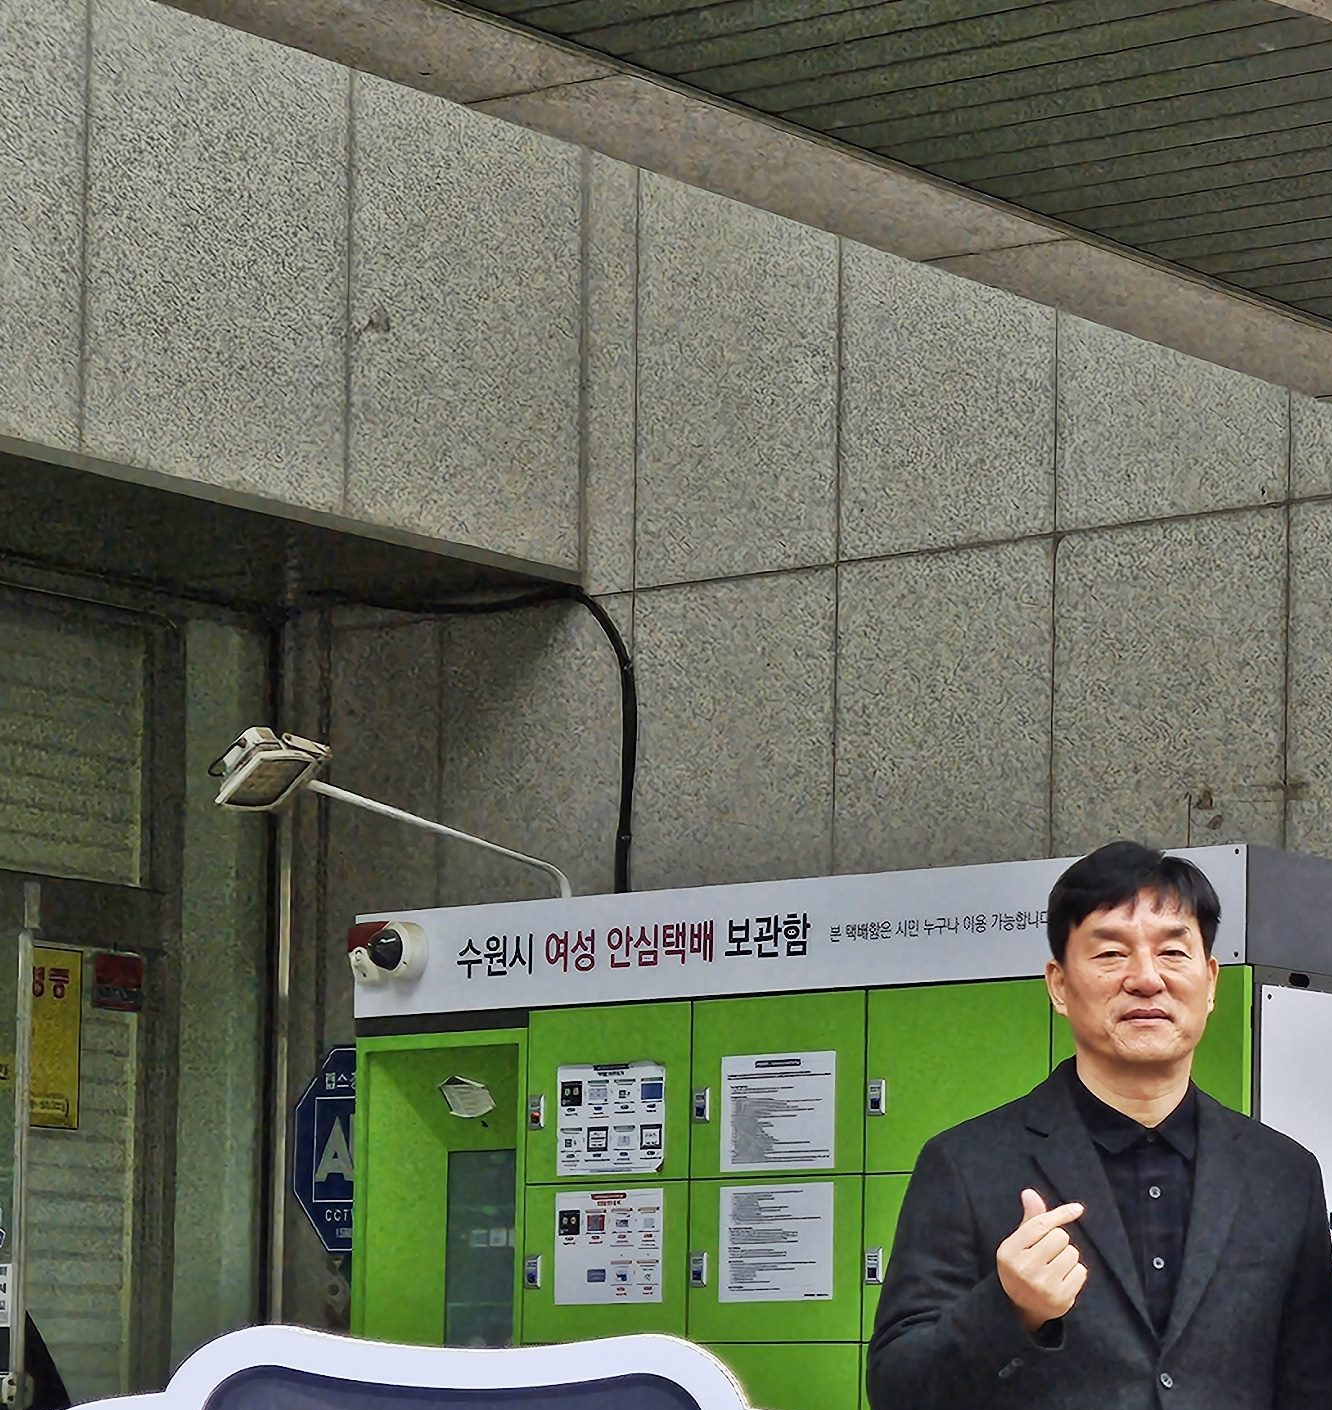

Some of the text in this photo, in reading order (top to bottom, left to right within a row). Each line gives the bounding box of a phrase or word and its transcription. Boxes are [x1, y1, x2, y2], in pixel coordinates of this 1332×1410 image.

[923, 917, 960, 935] 누구나
[963, 914, 987, 933] 이용
[456, 913, 811, 978] 수원시 여성 안심택배 보관함
[325, 1208, 353, 1222] CCT
